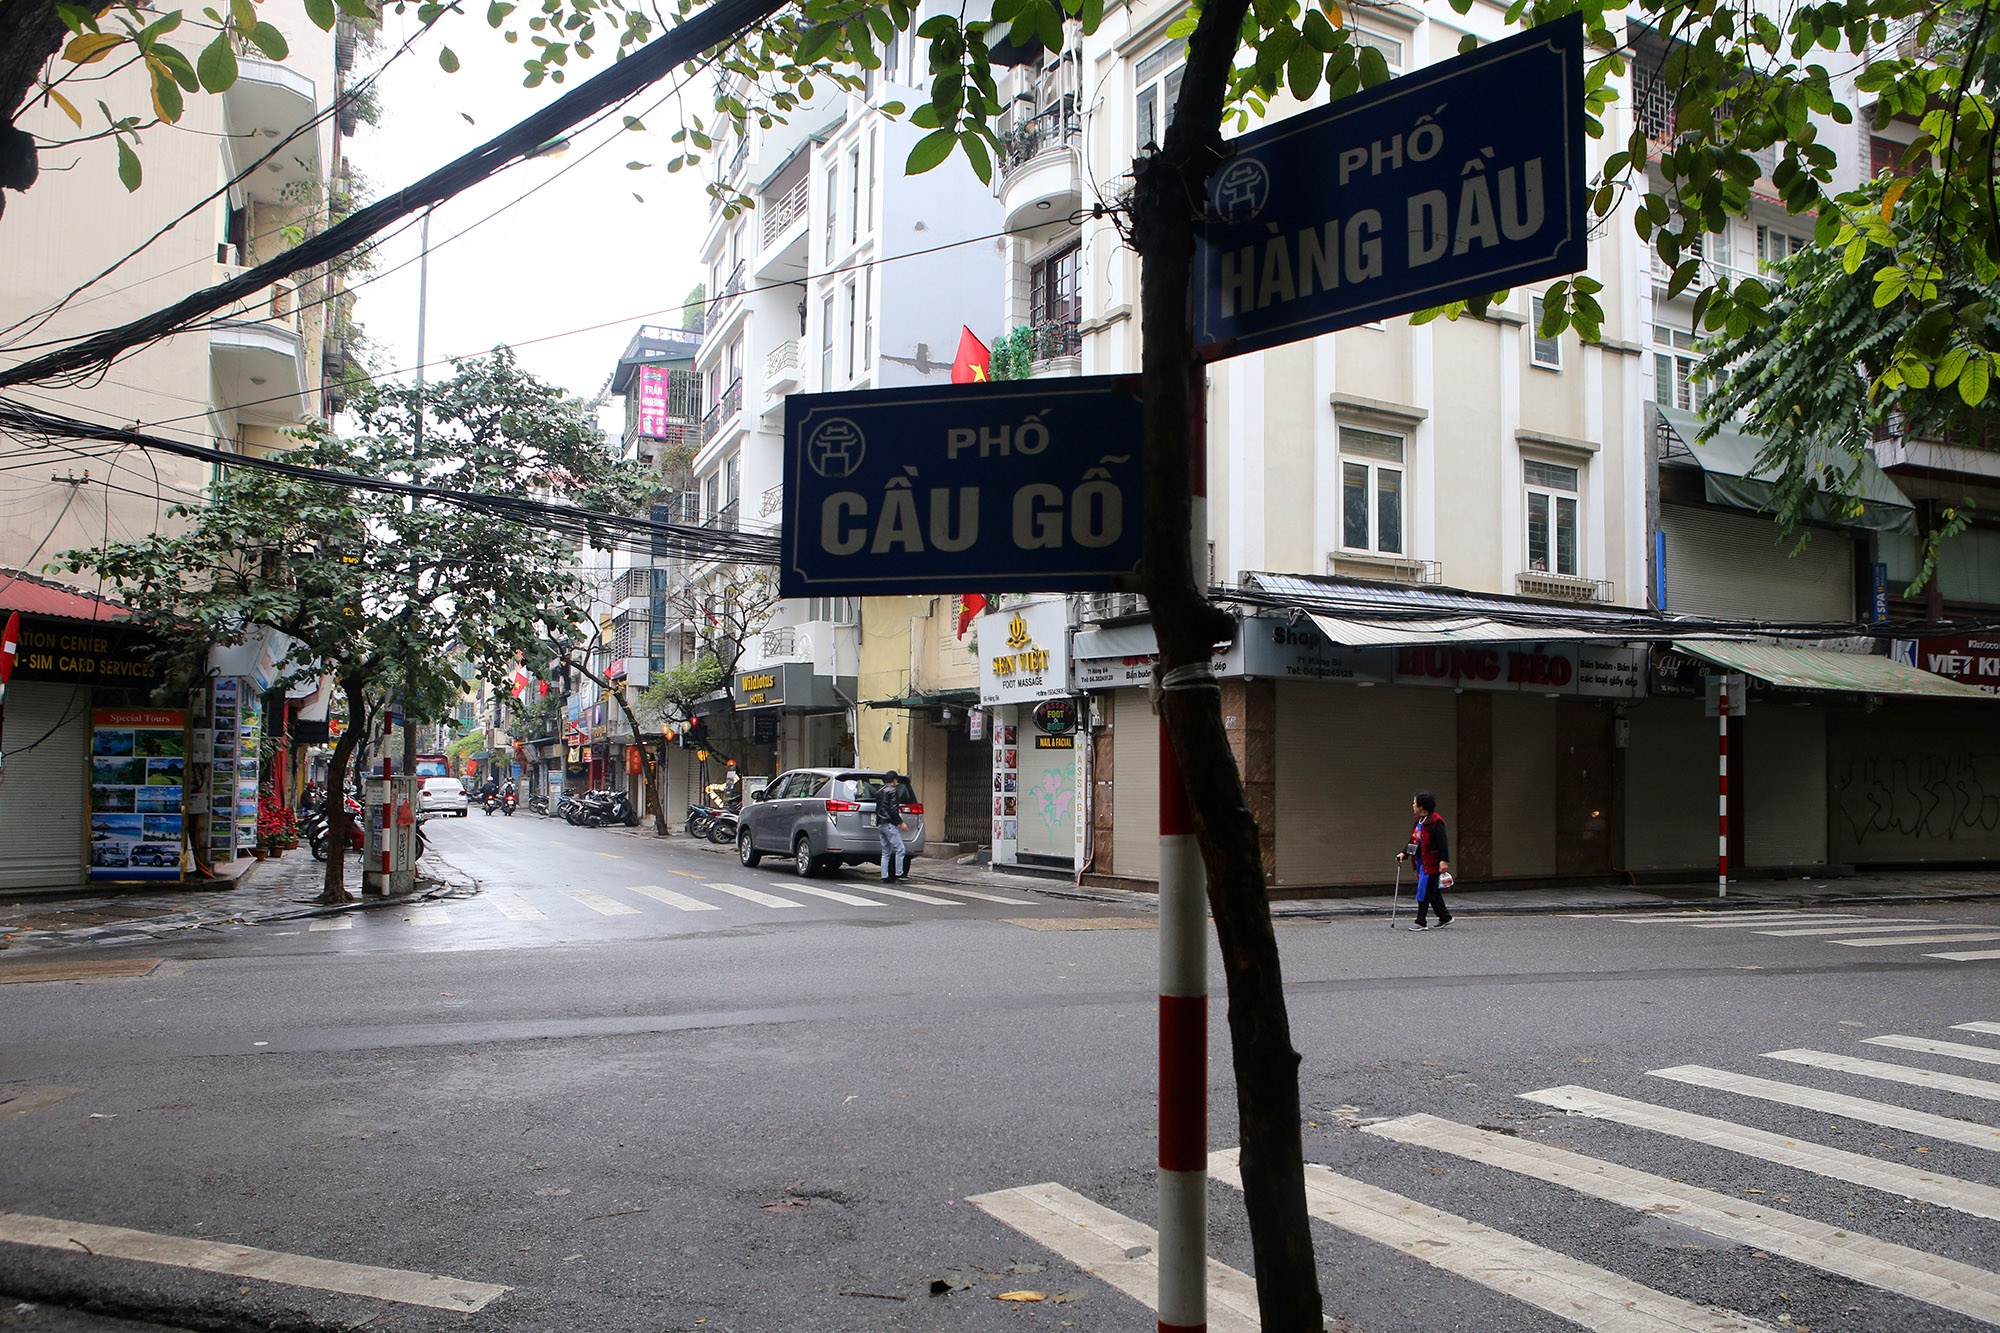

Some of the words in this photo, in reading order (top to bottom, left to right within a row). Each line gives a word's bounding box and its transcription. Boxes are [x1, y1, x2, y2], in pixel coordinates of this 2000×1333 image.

[1339, 104, 1447, 185] PHỐ
[1221, 211, 1383, 319] HÀNG
[1408, 146, 1545, 270] DẦU
[948, 409, 1053, 459] PHỐ
[821, 465, 980, 556] CẦU
[1012, 454, 1131, 551] GỖ
[1876, 592, 1886, 613] SPA
[16, 631, 56, 649] ATION
[60, 634, 109, 653] CENTER
[1273, 626, 1320, 649] Shop
[29, 653, 53, 671] SIM
[59, 655, 95, 673] CARD
[99, 659, 157, 678] SERVICES
[992, 655, 1016, 675] SEN
[1018, 645, 1050, 675] VIỆT
[1214, 661, 1227, 671] dép
[1297, 656, 1305, 664] 71
[1508, 644, 1572, 686] BÉO
[1580, 659, 1594, 669] Bán
[1596, 661, 1612, 670] buôn
[1617, 662, 1630, 672] Bán
[1927, 649, 1975, 678] VIỆT
[1287, 666, 1302, 675] Tel:
[1002, 680, 1016, 689] FOOT
[1017, 676, 1043, 688] MASSAGE
[750, 693, 766, 704] HOTEL
[1038, 701, 1073, 717] MASSAGE
[1047, 710, 1064, 718] FOOT
[110, 713, 142, 724] Special
[145, 714, 170, 722] Tours
[1047, 722, 1065, 731] BODY
[1040, 737, 1051, 747] NAIL
[1051, 738, 1055, 747] &
[1056, 738, 1072, 747] FACIAL
